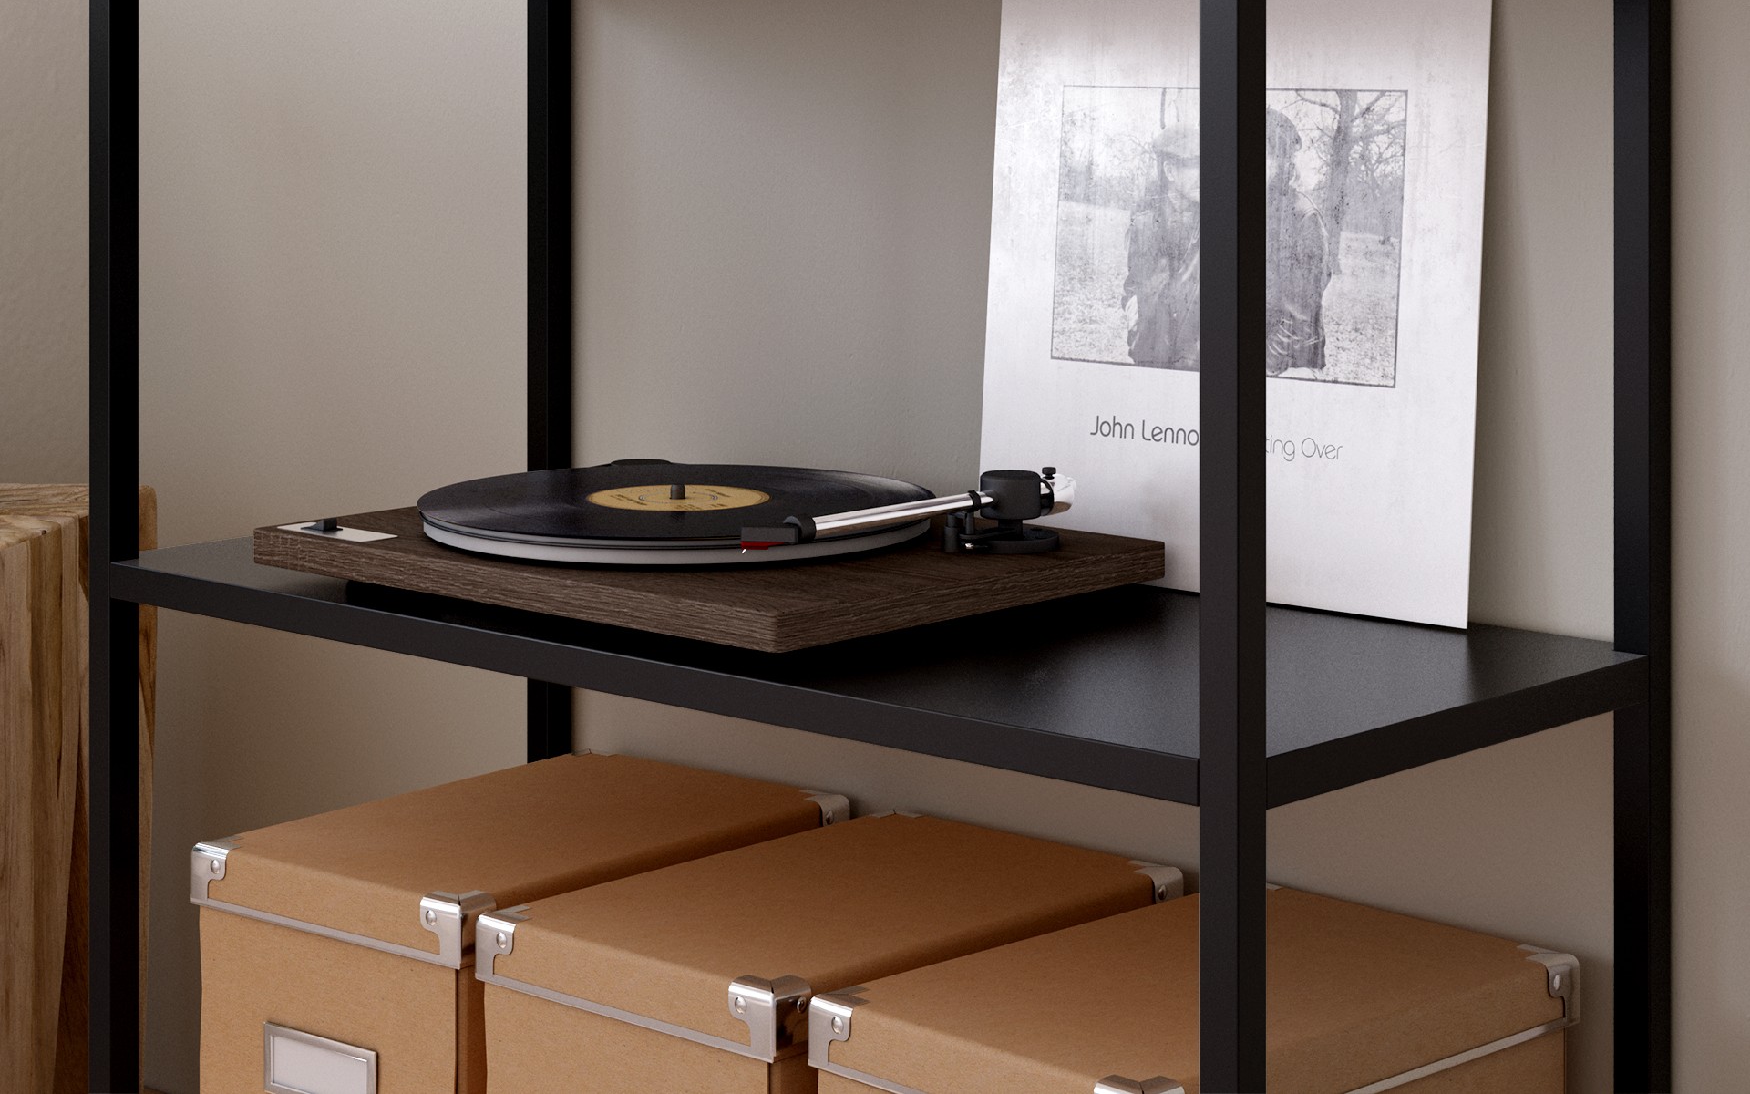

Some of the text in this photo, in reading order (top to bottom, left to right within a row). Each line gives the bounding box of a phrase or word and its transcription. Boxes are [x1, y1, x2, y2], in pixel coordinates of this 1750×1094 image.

[1090, 415, 1135, 440] John
[1142, 419, 1200, 447] Lenno
[1301, 437, 1344, 460] Over
